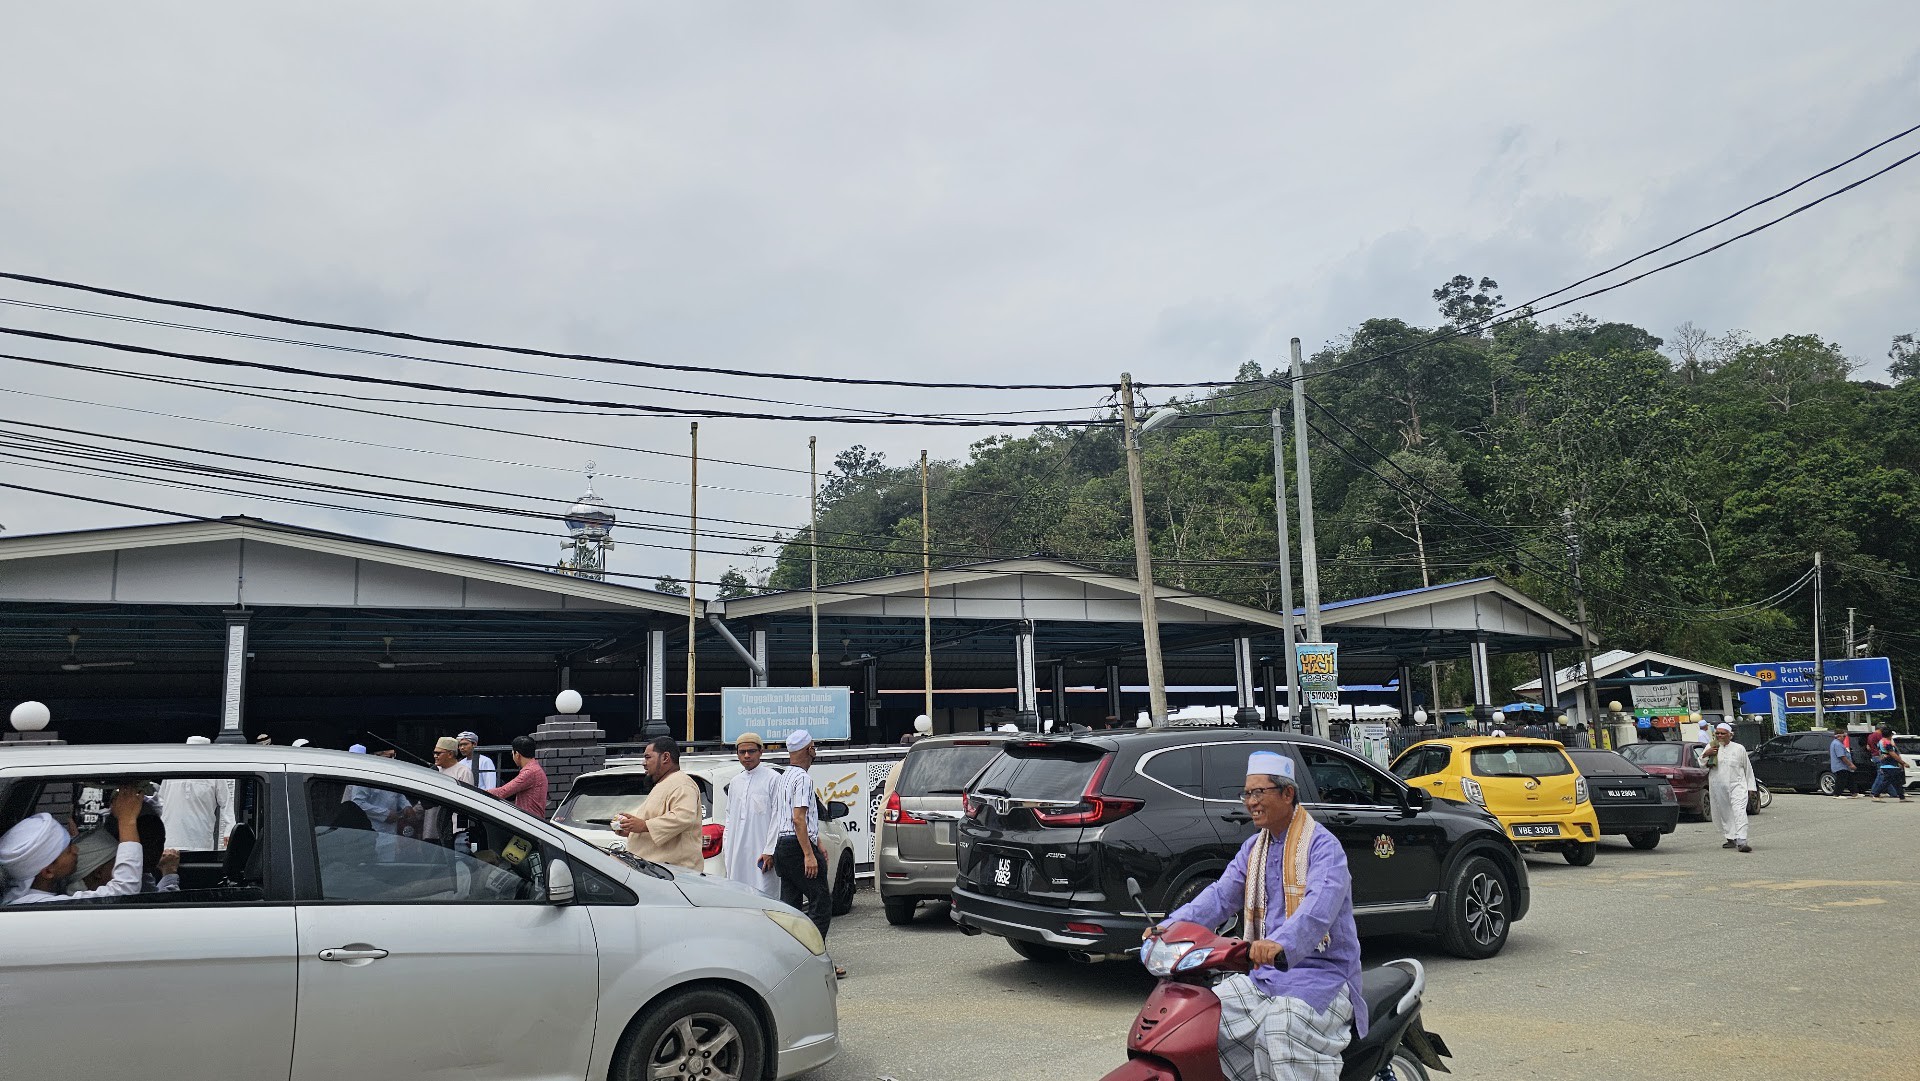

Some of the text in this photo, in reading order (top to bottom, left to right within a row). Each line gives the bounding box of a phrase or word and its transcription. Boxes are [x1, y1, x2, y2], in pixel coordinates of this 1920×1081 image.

[1300, 654, 1333, 664] UPAH
[1302, 663, 1334, 673] HAJI
[1780, 666, 1816, 674] Benton
[1760, 671, 1772, 679] 68
[742, 693, 832, 704] Tinggalkan Urusan Dunia
[777, 705, 799, 714] Untuk
[819, 704, 836, 714] Agar
[745, 716, 829, 727] Tidak Tersesat Di Dunia
[766, 729, 781, 738] Dan
[1518, 826, 1554, 835] VBE 3308
